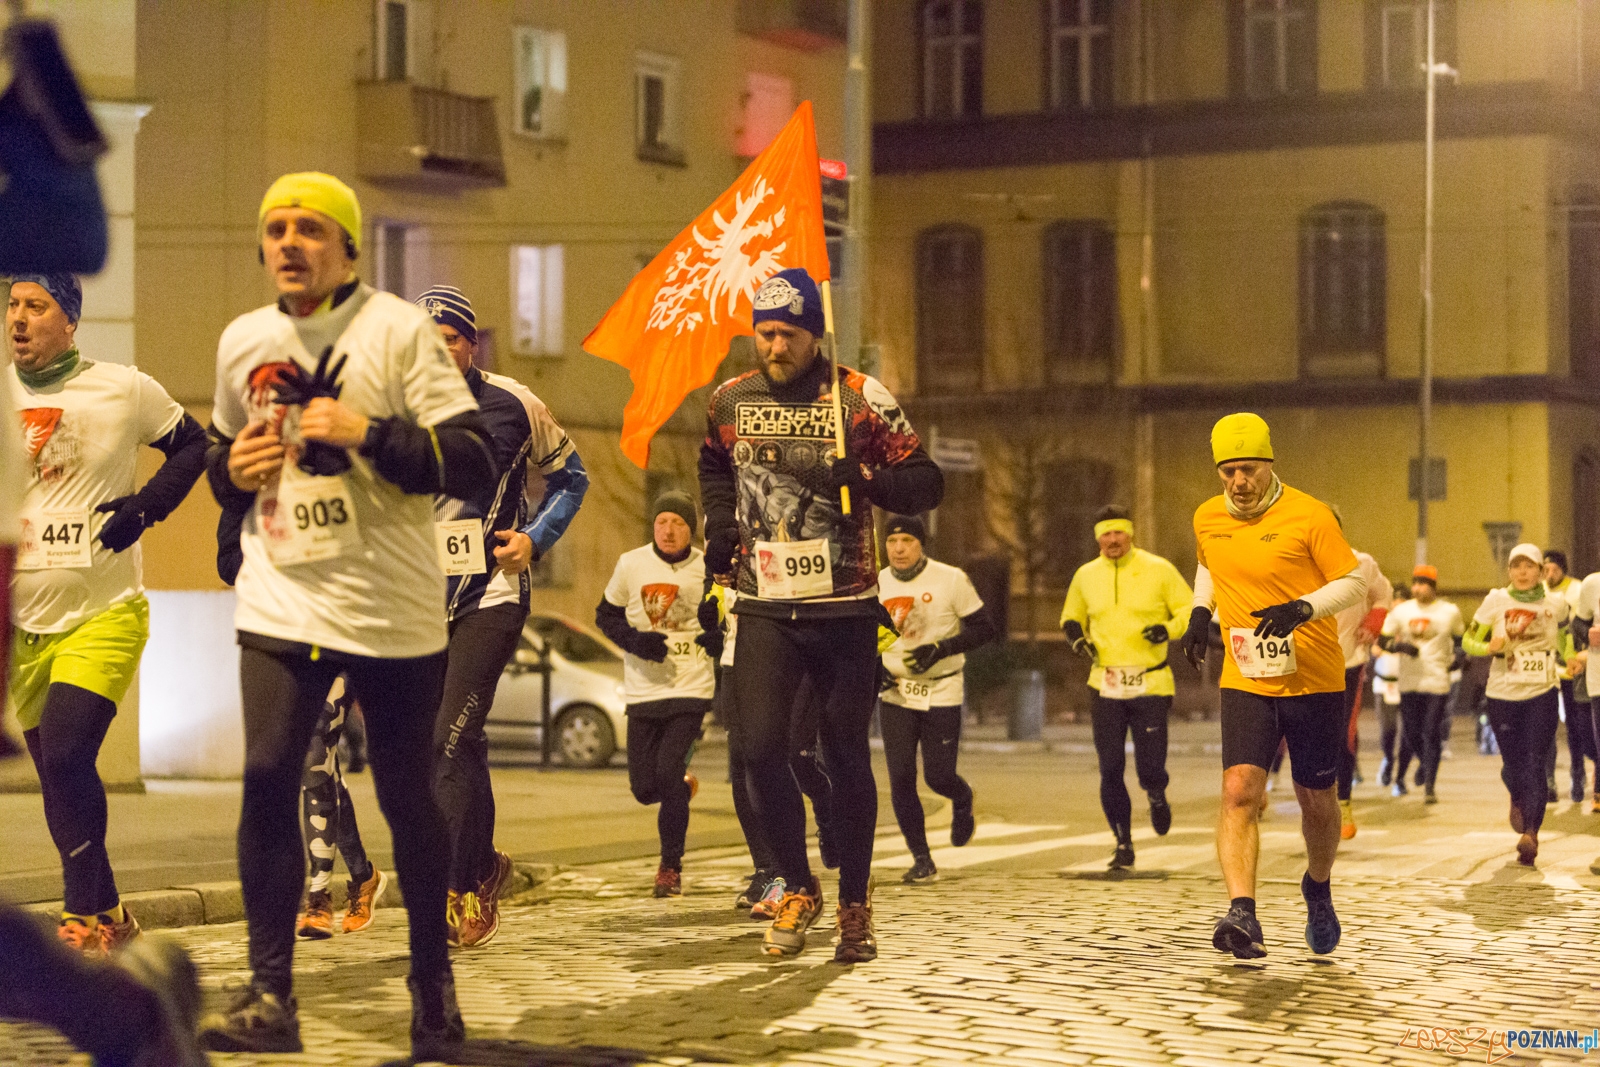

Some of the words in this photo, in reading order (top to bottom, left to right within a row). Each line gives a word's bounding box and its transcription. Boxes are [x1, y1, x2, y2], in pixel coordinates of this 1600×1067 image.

[739, 421, 806, 435] HOBBY
[295, 498, 348, 530] 903
[42, 523, 84, 545] 447
[446, 534, 471, 555] 61
[785, 554, 826, 577] 999
[674, 642, 690, 655] 32
[1255, 639, 1291, 659] 194
[1523, 660, 1544, 671] 228
[1120, 675, 1143, 686] 429
[905, 682, 928, 697] 566
